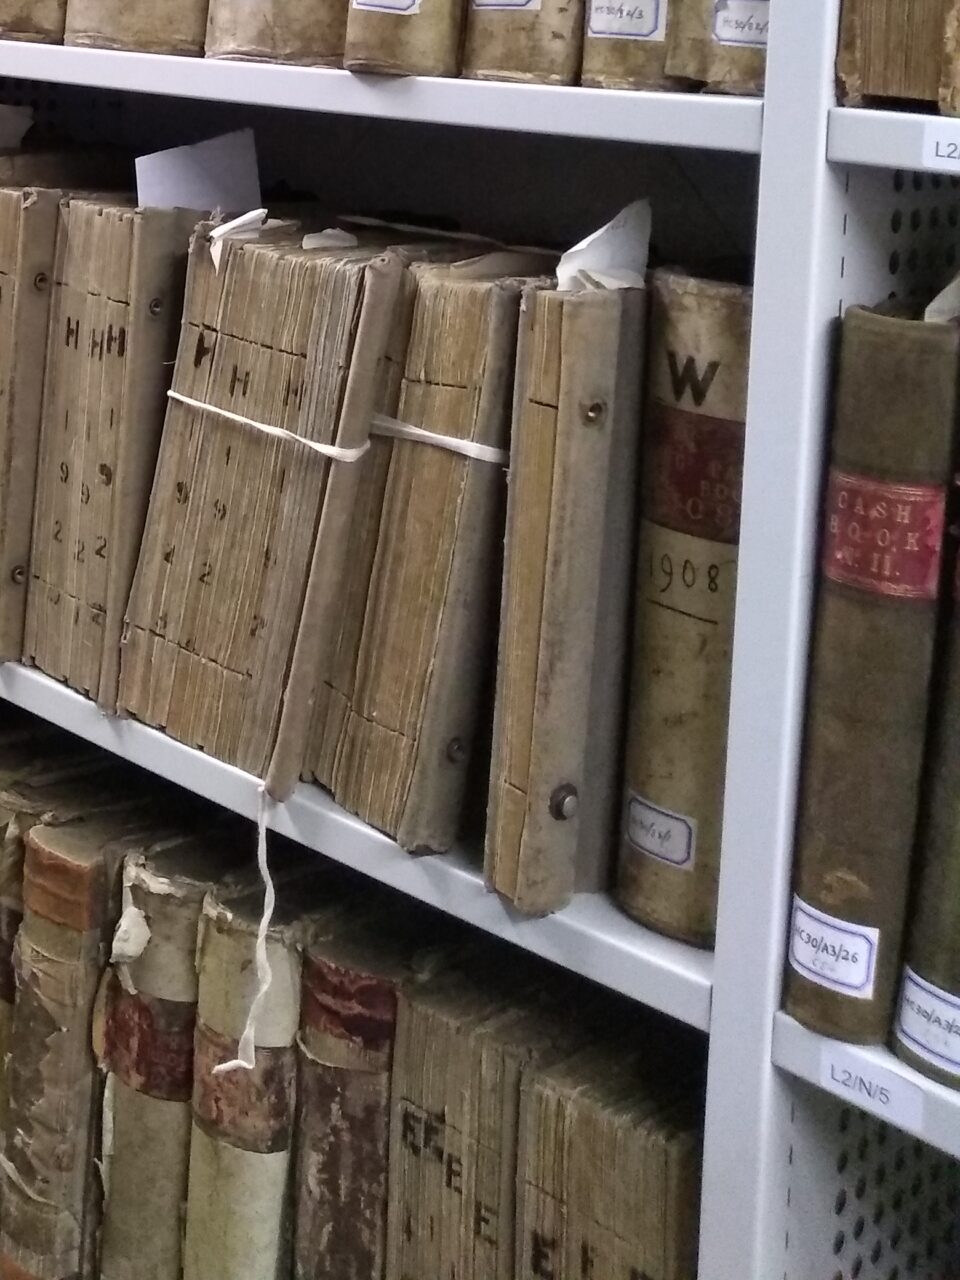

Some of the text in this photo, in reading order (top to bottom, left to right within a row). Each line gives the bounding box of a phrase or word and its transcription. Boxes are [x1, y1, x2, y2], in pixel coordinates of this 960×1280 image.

[65, 316, 80, 350] H
[106, 323, 126, 358] H
[229, 363, 251, 399] H
[666, 348, 722, 408] W
[837, 489, 913, 525] CASH
[647, 551, 720, 594] 1908
[830, 1062, 891, 1107] L2/N/5
[445, 1152, 464, 1195] E
